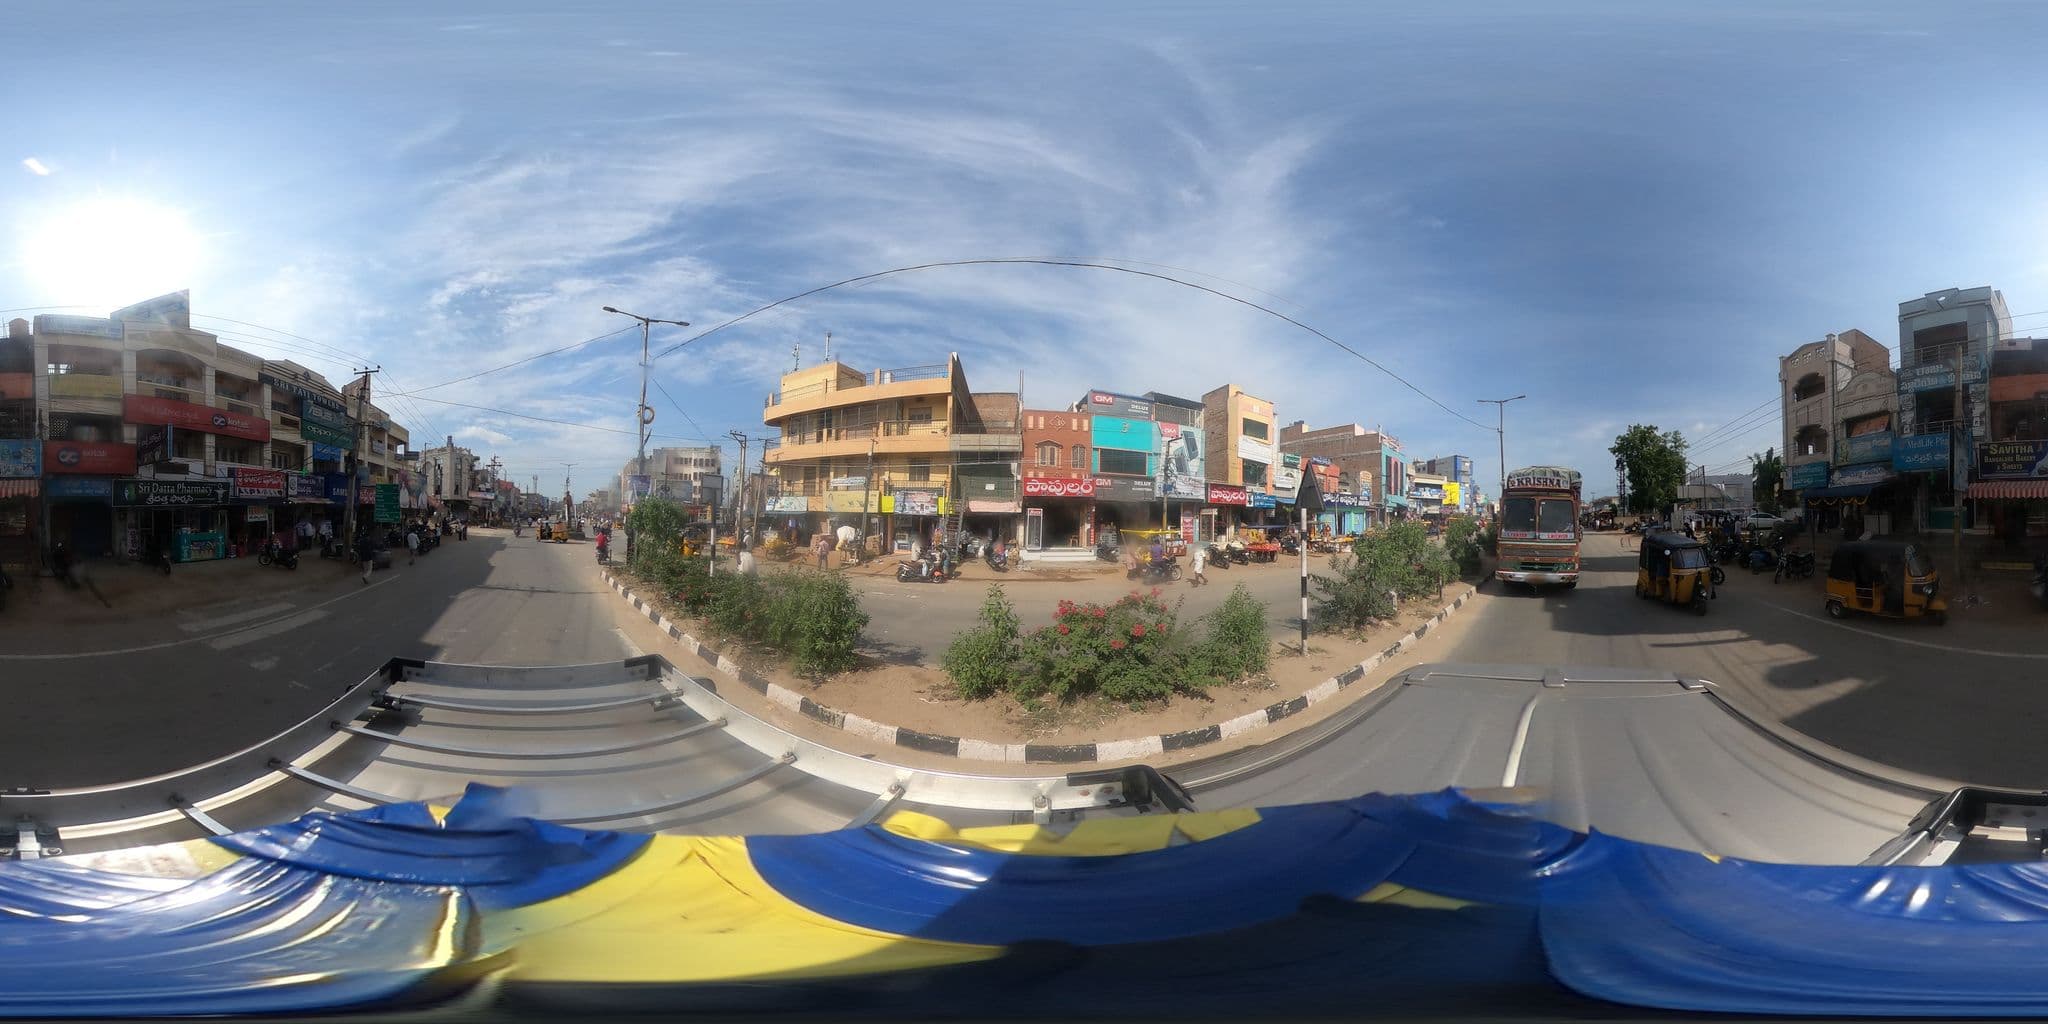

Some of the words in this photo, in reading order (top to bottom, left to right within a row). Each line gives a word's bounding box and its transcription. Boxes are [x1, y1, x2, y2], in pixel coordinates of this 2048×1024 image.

[1989, 444, 2033, 454] SAVITHA
[1517, 477, 1561, 488] KRISHNA
[138, 483, 151, 494] Sri
[152, 482, 175, 494] Datta
[177, 482, 212, 496] Pharmacy
